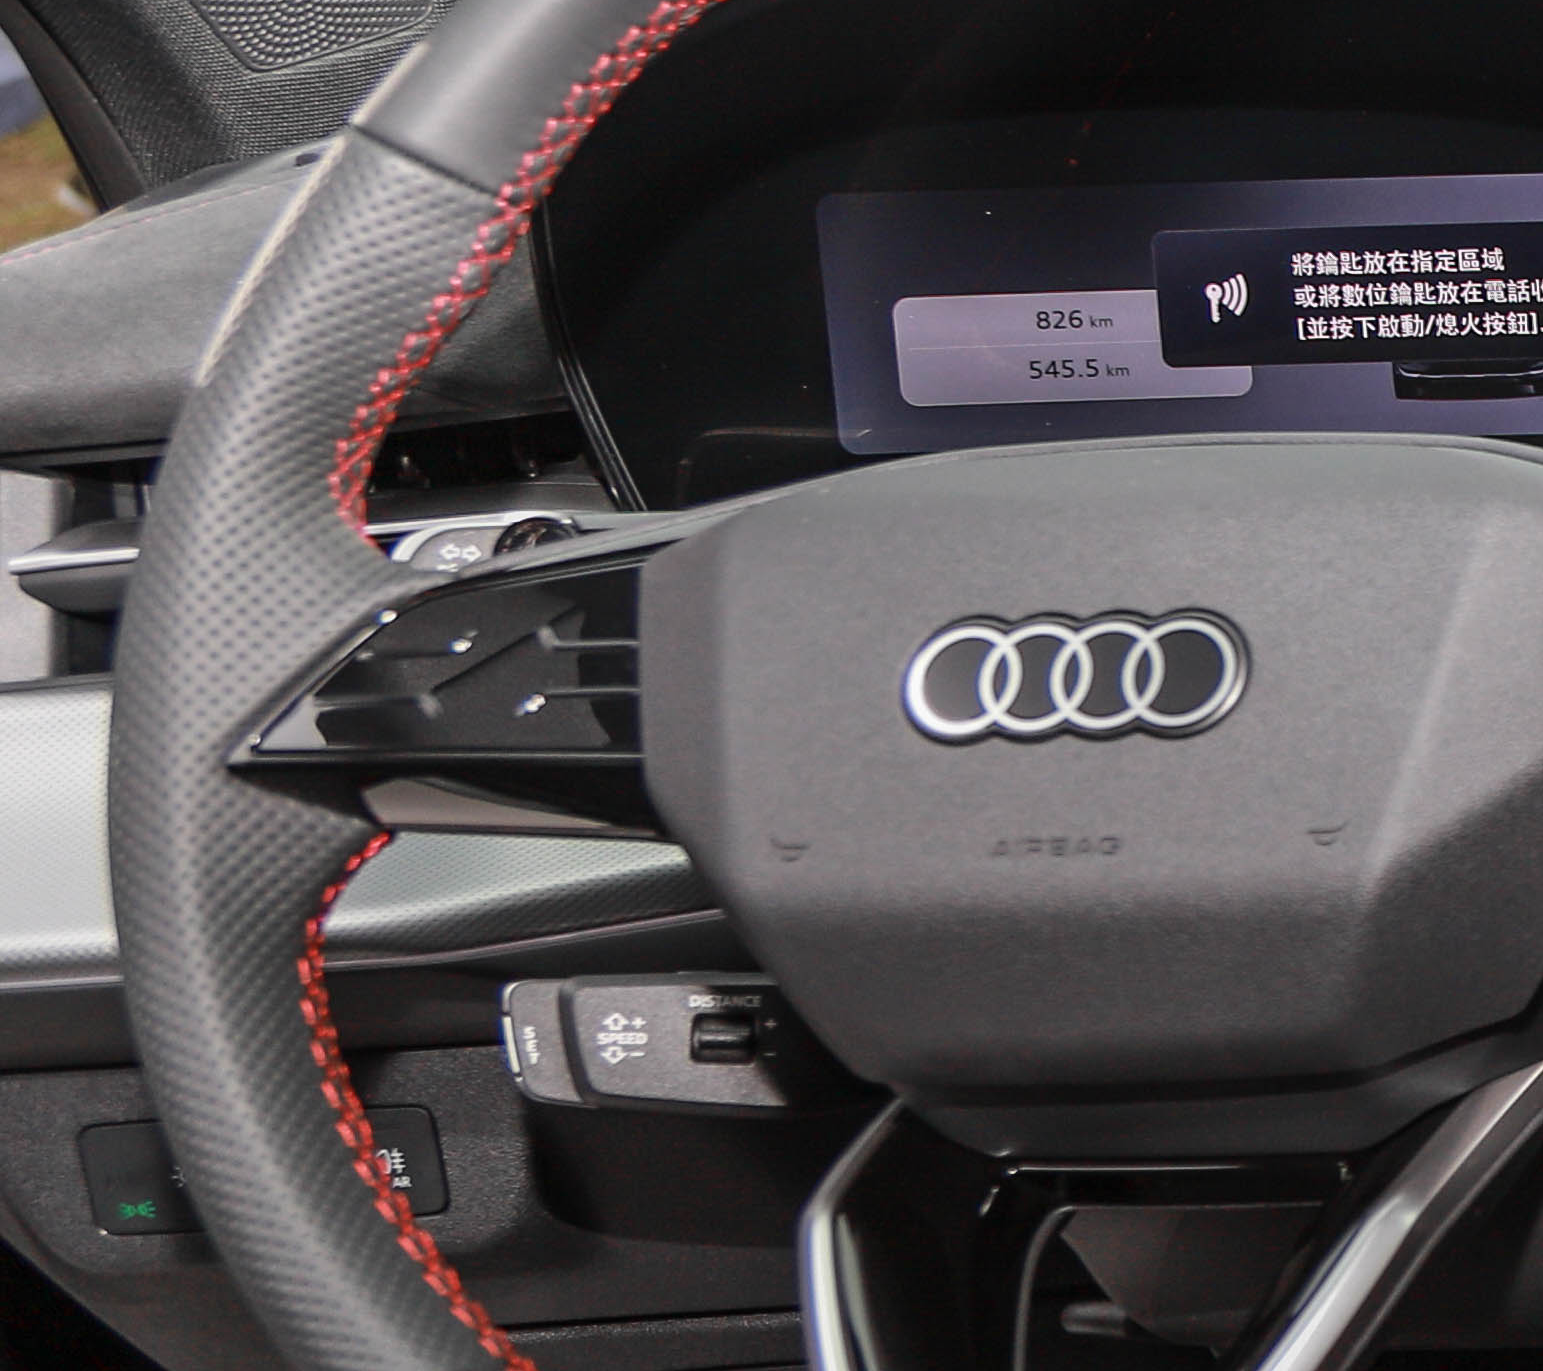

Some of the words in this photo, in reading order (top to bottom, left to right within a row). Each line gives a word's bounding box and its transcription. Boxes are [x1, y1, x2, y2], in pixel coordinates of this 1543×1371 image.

[1291, 248, 1505, 277] 將鑰匙放在指定區域
[1035, 309, 1084, 330] 826
[1089, 315, 1114, 328] km
[1028, 358, 1100, 379] 545.5
[1106, 364, 1130, 378] km
[688, 994, 764, 1009] DISTANCE
[522, 1025, 541, 1066] SET
[596, 1032, 648, 1046] SPEED
